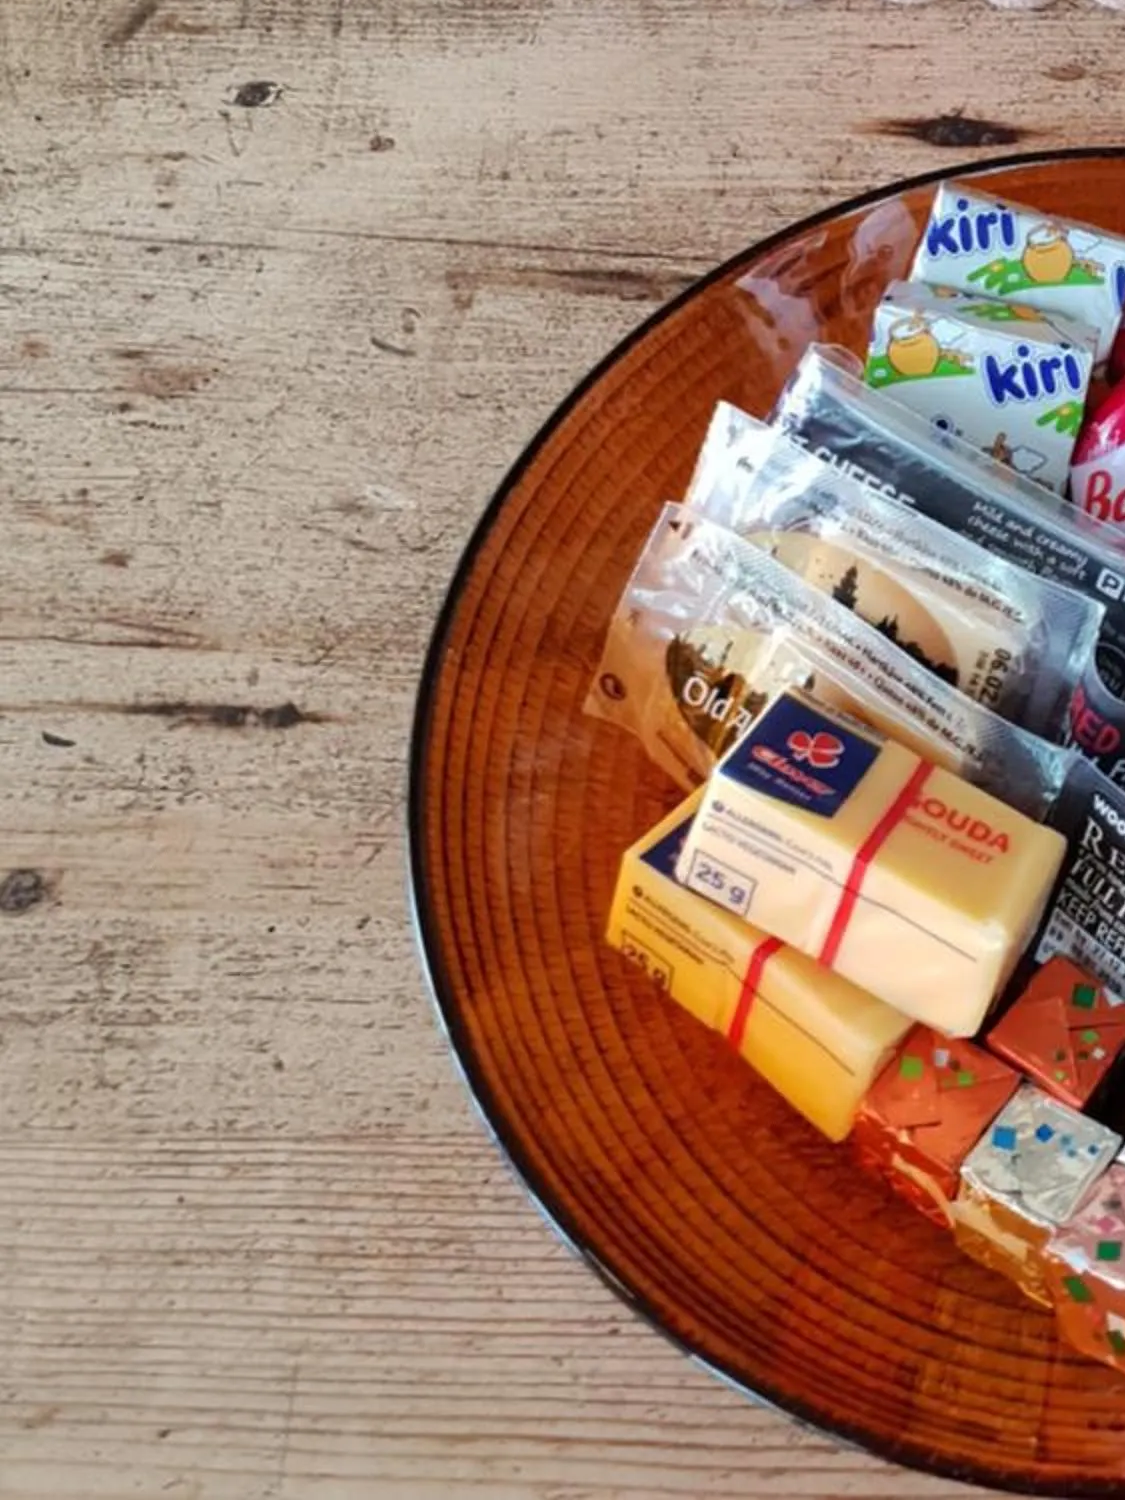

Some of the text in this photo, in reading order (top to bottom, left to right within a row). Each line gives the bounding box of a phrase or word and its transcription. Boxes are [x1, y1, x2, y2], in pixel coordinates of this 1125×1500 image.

[927, 198, 1015, 257] kiri
[985, 344, 1081, 404] kiri
[682, 674, 735, 722] Old
[911, 797, 1010, 854] OUDA
[695, 861, 747, 907] 25 g
[1055, 888, 1097, 925] KEEP
[1070, 858, 1116, 910] FULL
